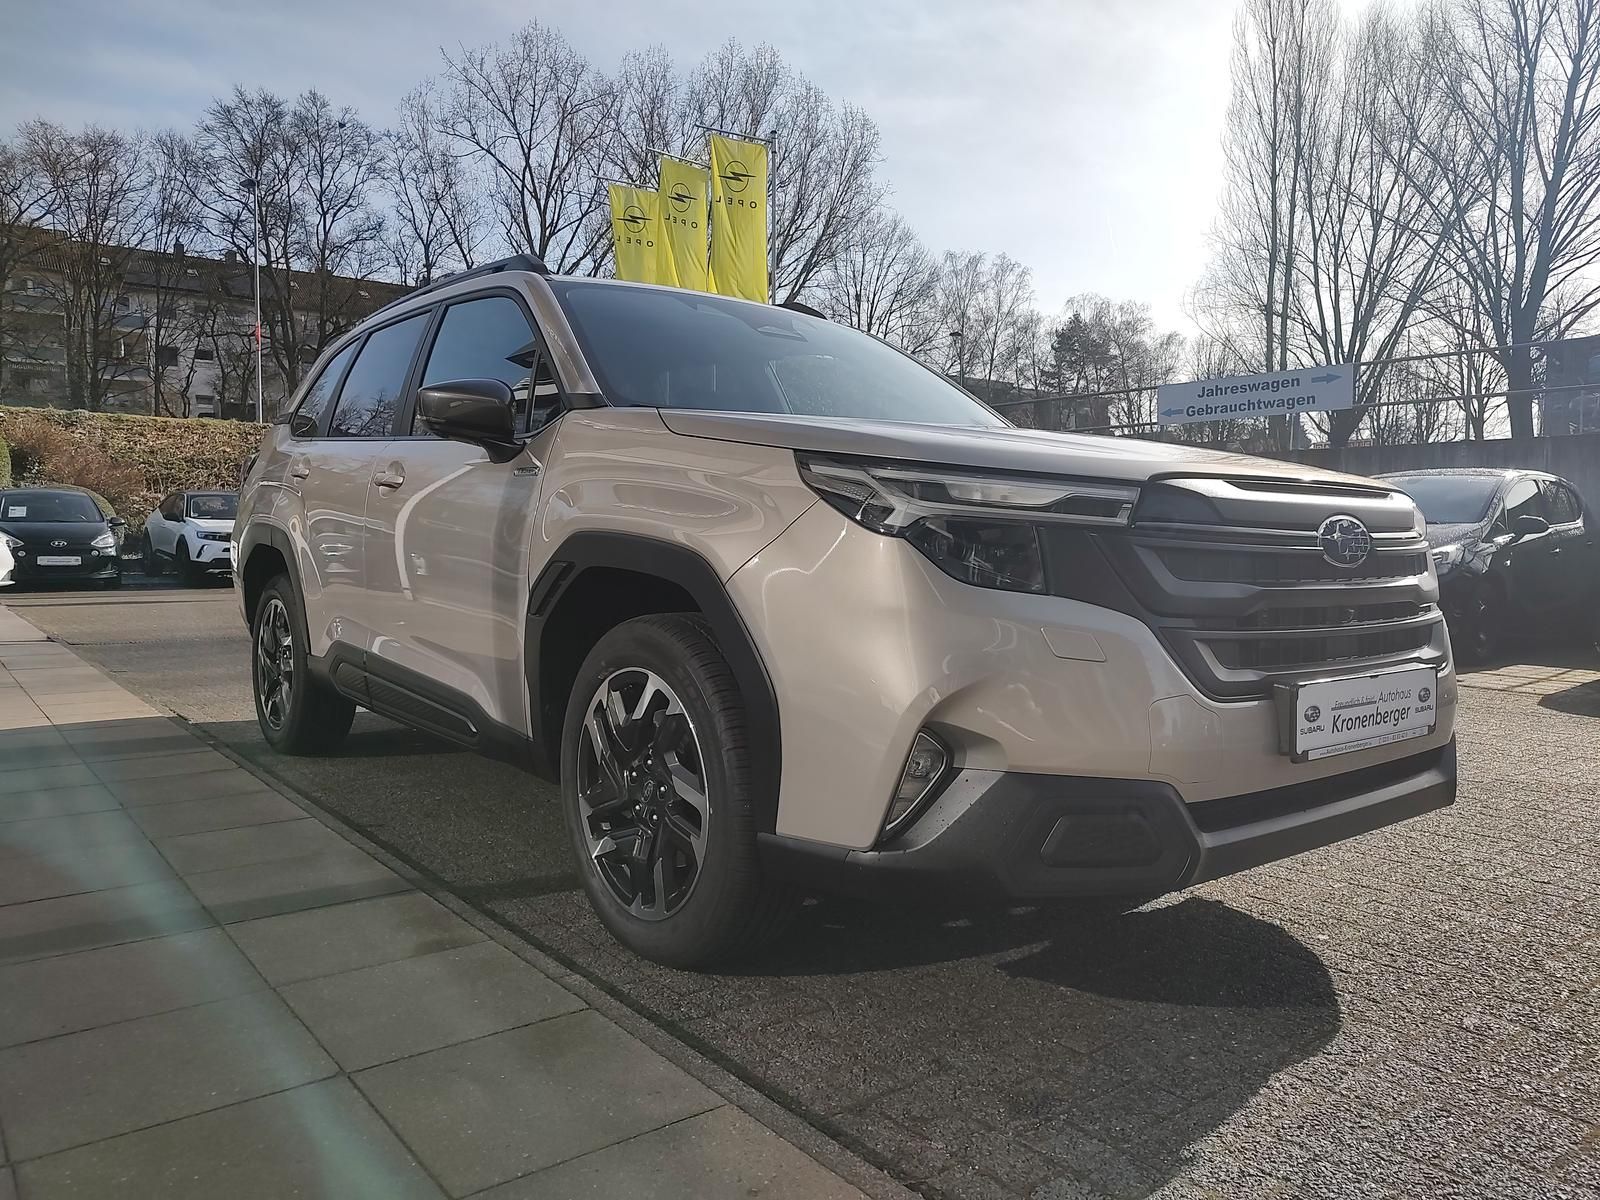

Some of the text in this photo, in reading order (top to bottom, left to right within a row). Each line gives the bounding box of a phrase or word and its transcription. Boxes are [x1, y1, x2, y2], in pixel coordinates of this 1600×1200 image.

[1197, 377, 1300, 399] Jahreswagen
[1186, 394, 1316, 418] Gebrauchtwagen
[1378, 688, 1412, 703] Autohaus
[1415, 705, 1434, 714] SUBARU
[1332, 706, 1411, 734] Kronenberger
[1300, 725, 1325, 736] SUBARU
